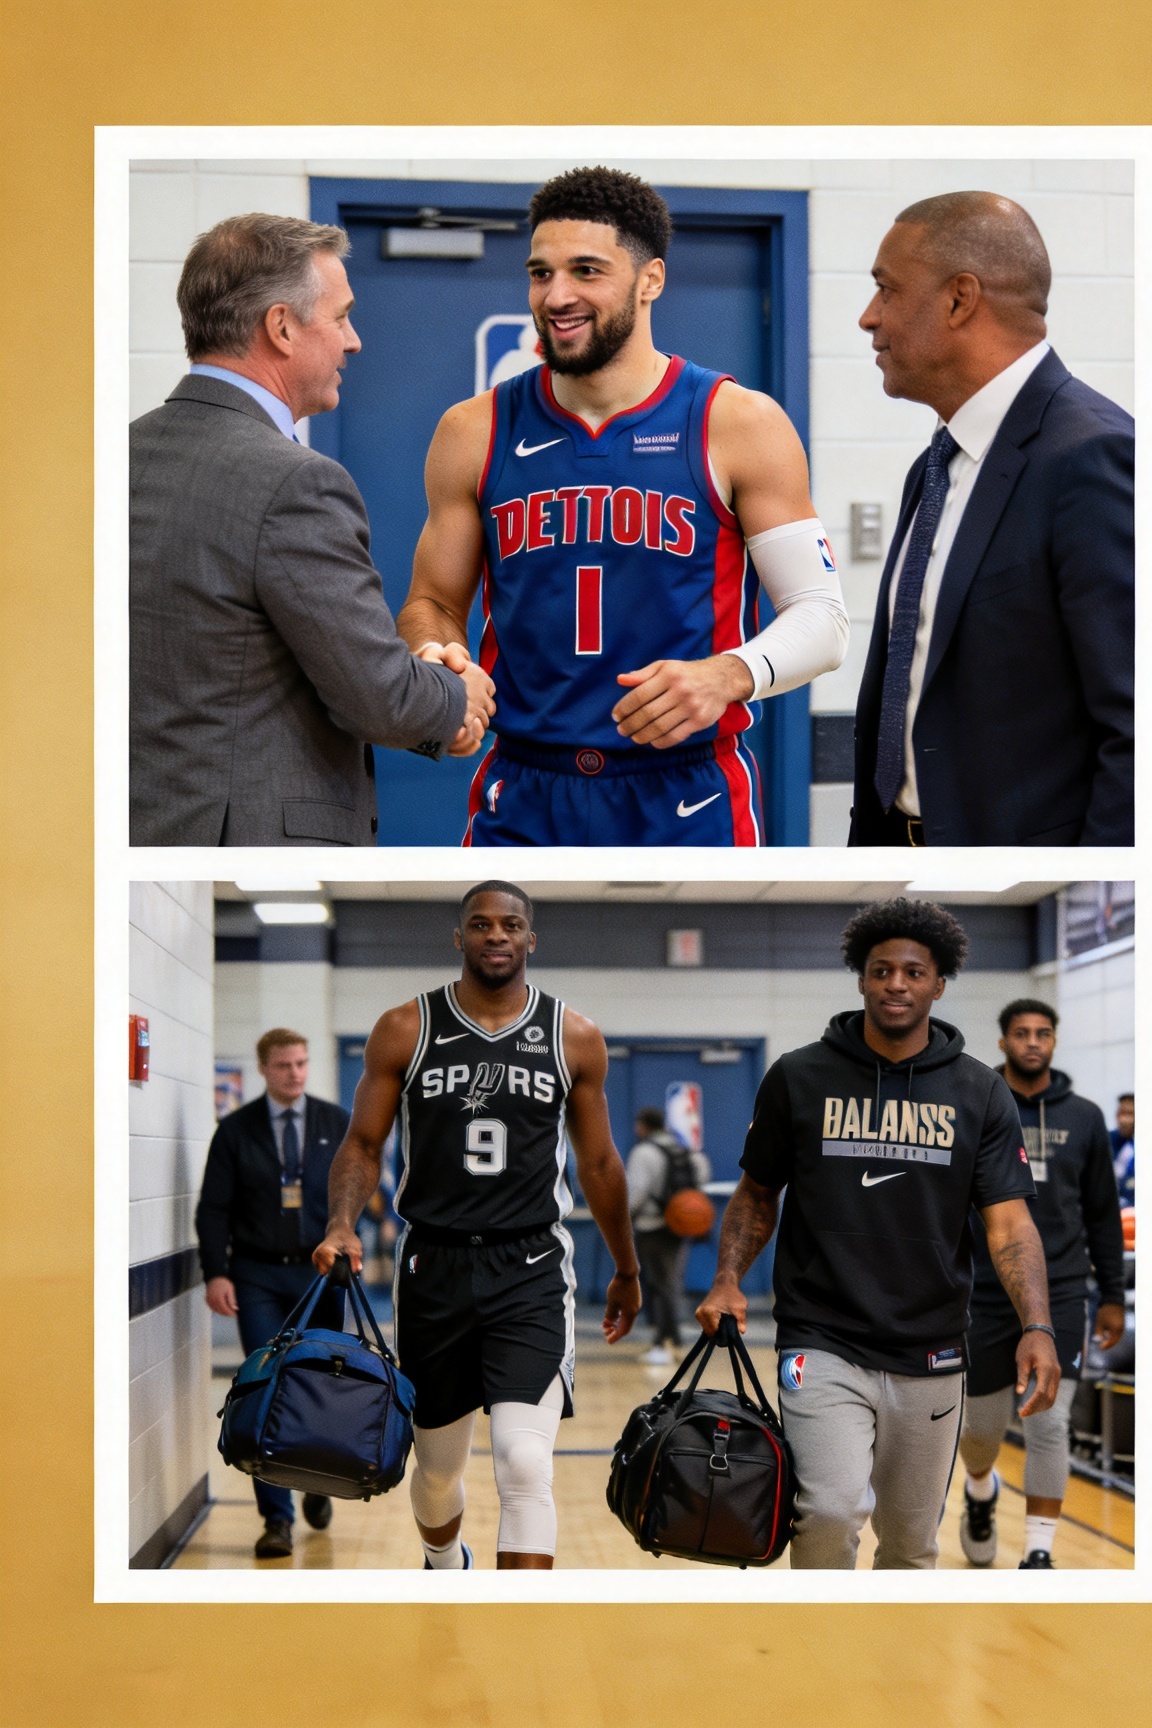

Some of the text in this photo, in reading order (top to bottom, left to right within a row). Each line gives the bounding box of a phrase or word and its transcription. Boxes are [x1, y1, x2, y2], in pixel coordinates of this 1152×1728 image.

[575, 566, 602, 655] 1
[422, 1062, 556, 1117] SPURS
[463, 1118, 508, 1177] 9
